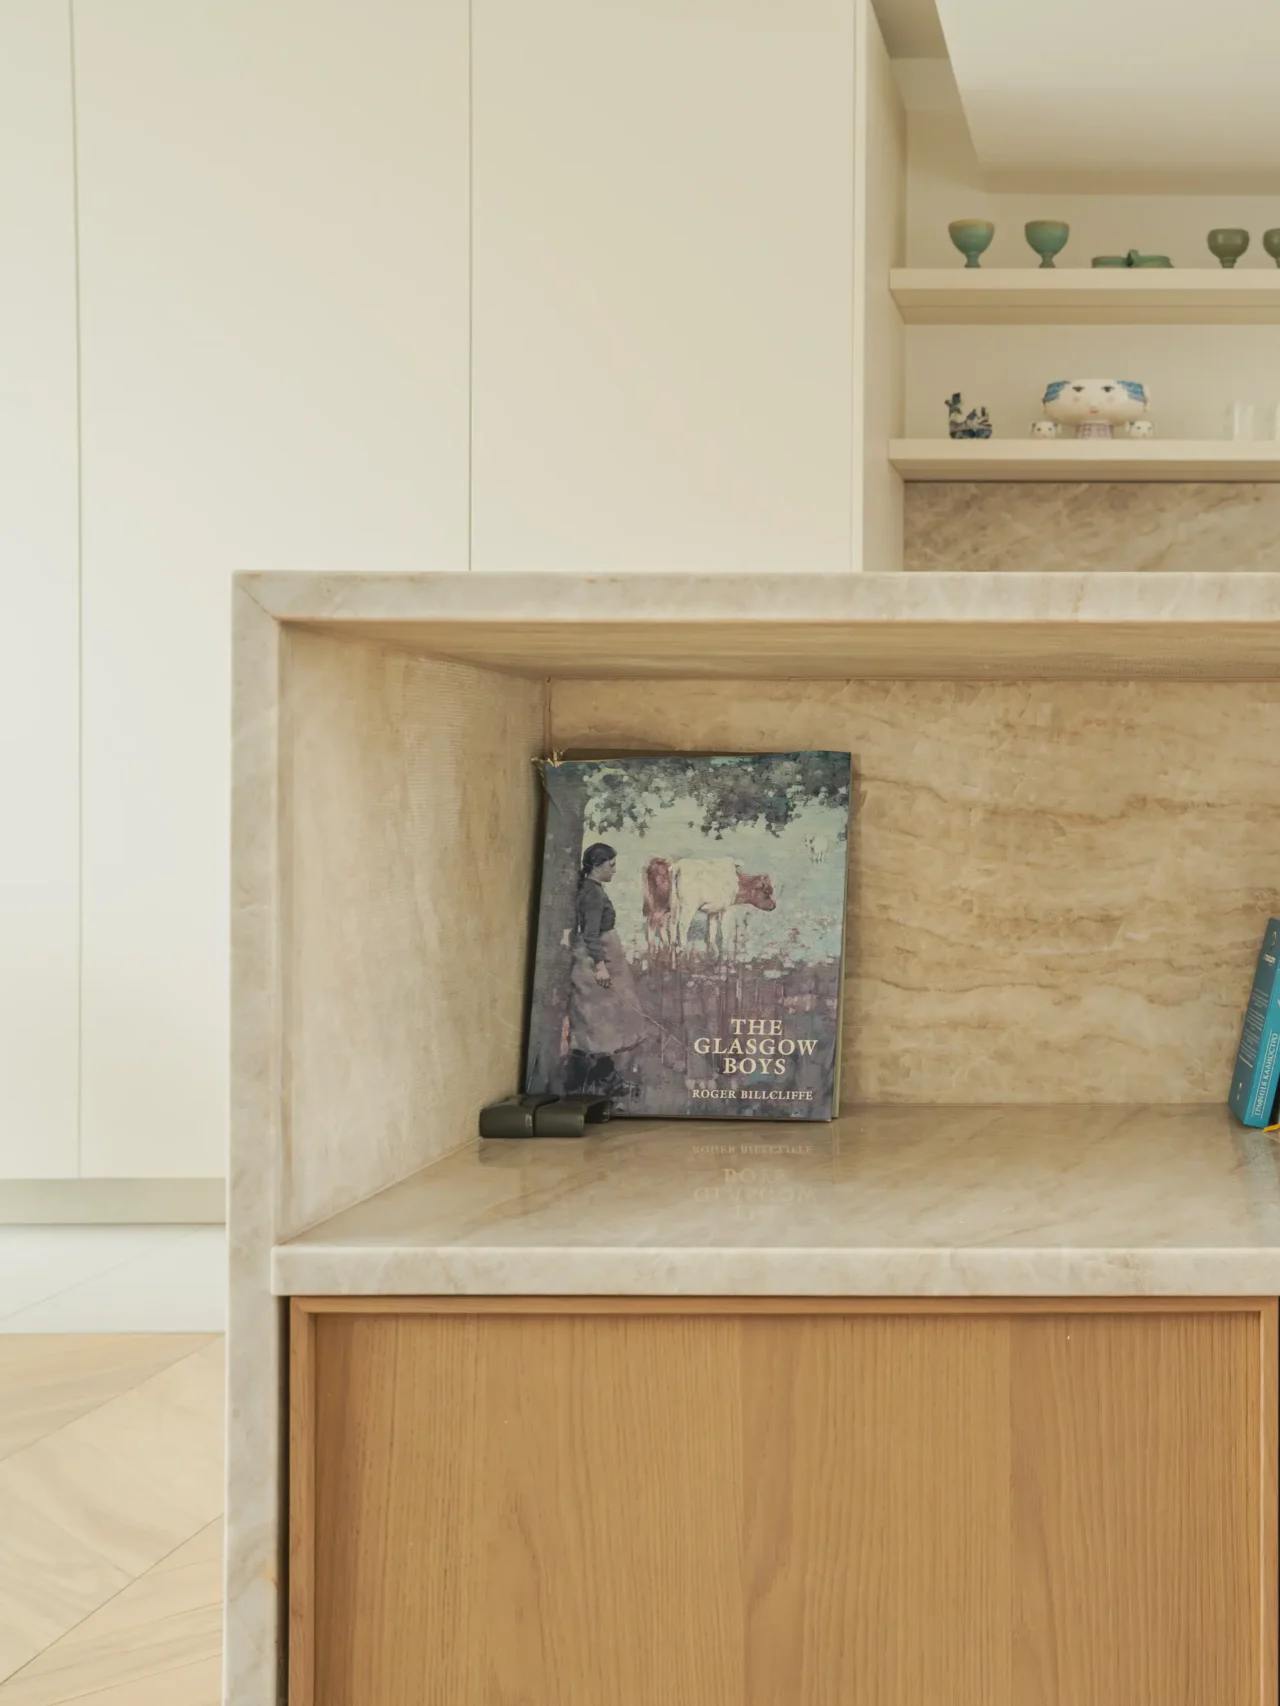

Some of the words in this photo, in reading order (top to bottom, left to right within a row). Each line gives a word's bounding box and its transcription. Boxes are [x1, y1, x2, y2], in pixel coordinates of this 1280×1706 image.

[731, 1018, 783, 1036] THE
[693, 1037, 819, 1056] GLASGOW
[1261, 1032, 1280, 1081] КАЛИОСТРО
[722, 1057, 786, 1075] BOYS
[692, 1089, 737, 1099] ROGER
[741, 1090, 813, 1100] BILLCLIFFE
[1255, 1082, 1269, 1117] ГРАФИНЯ
